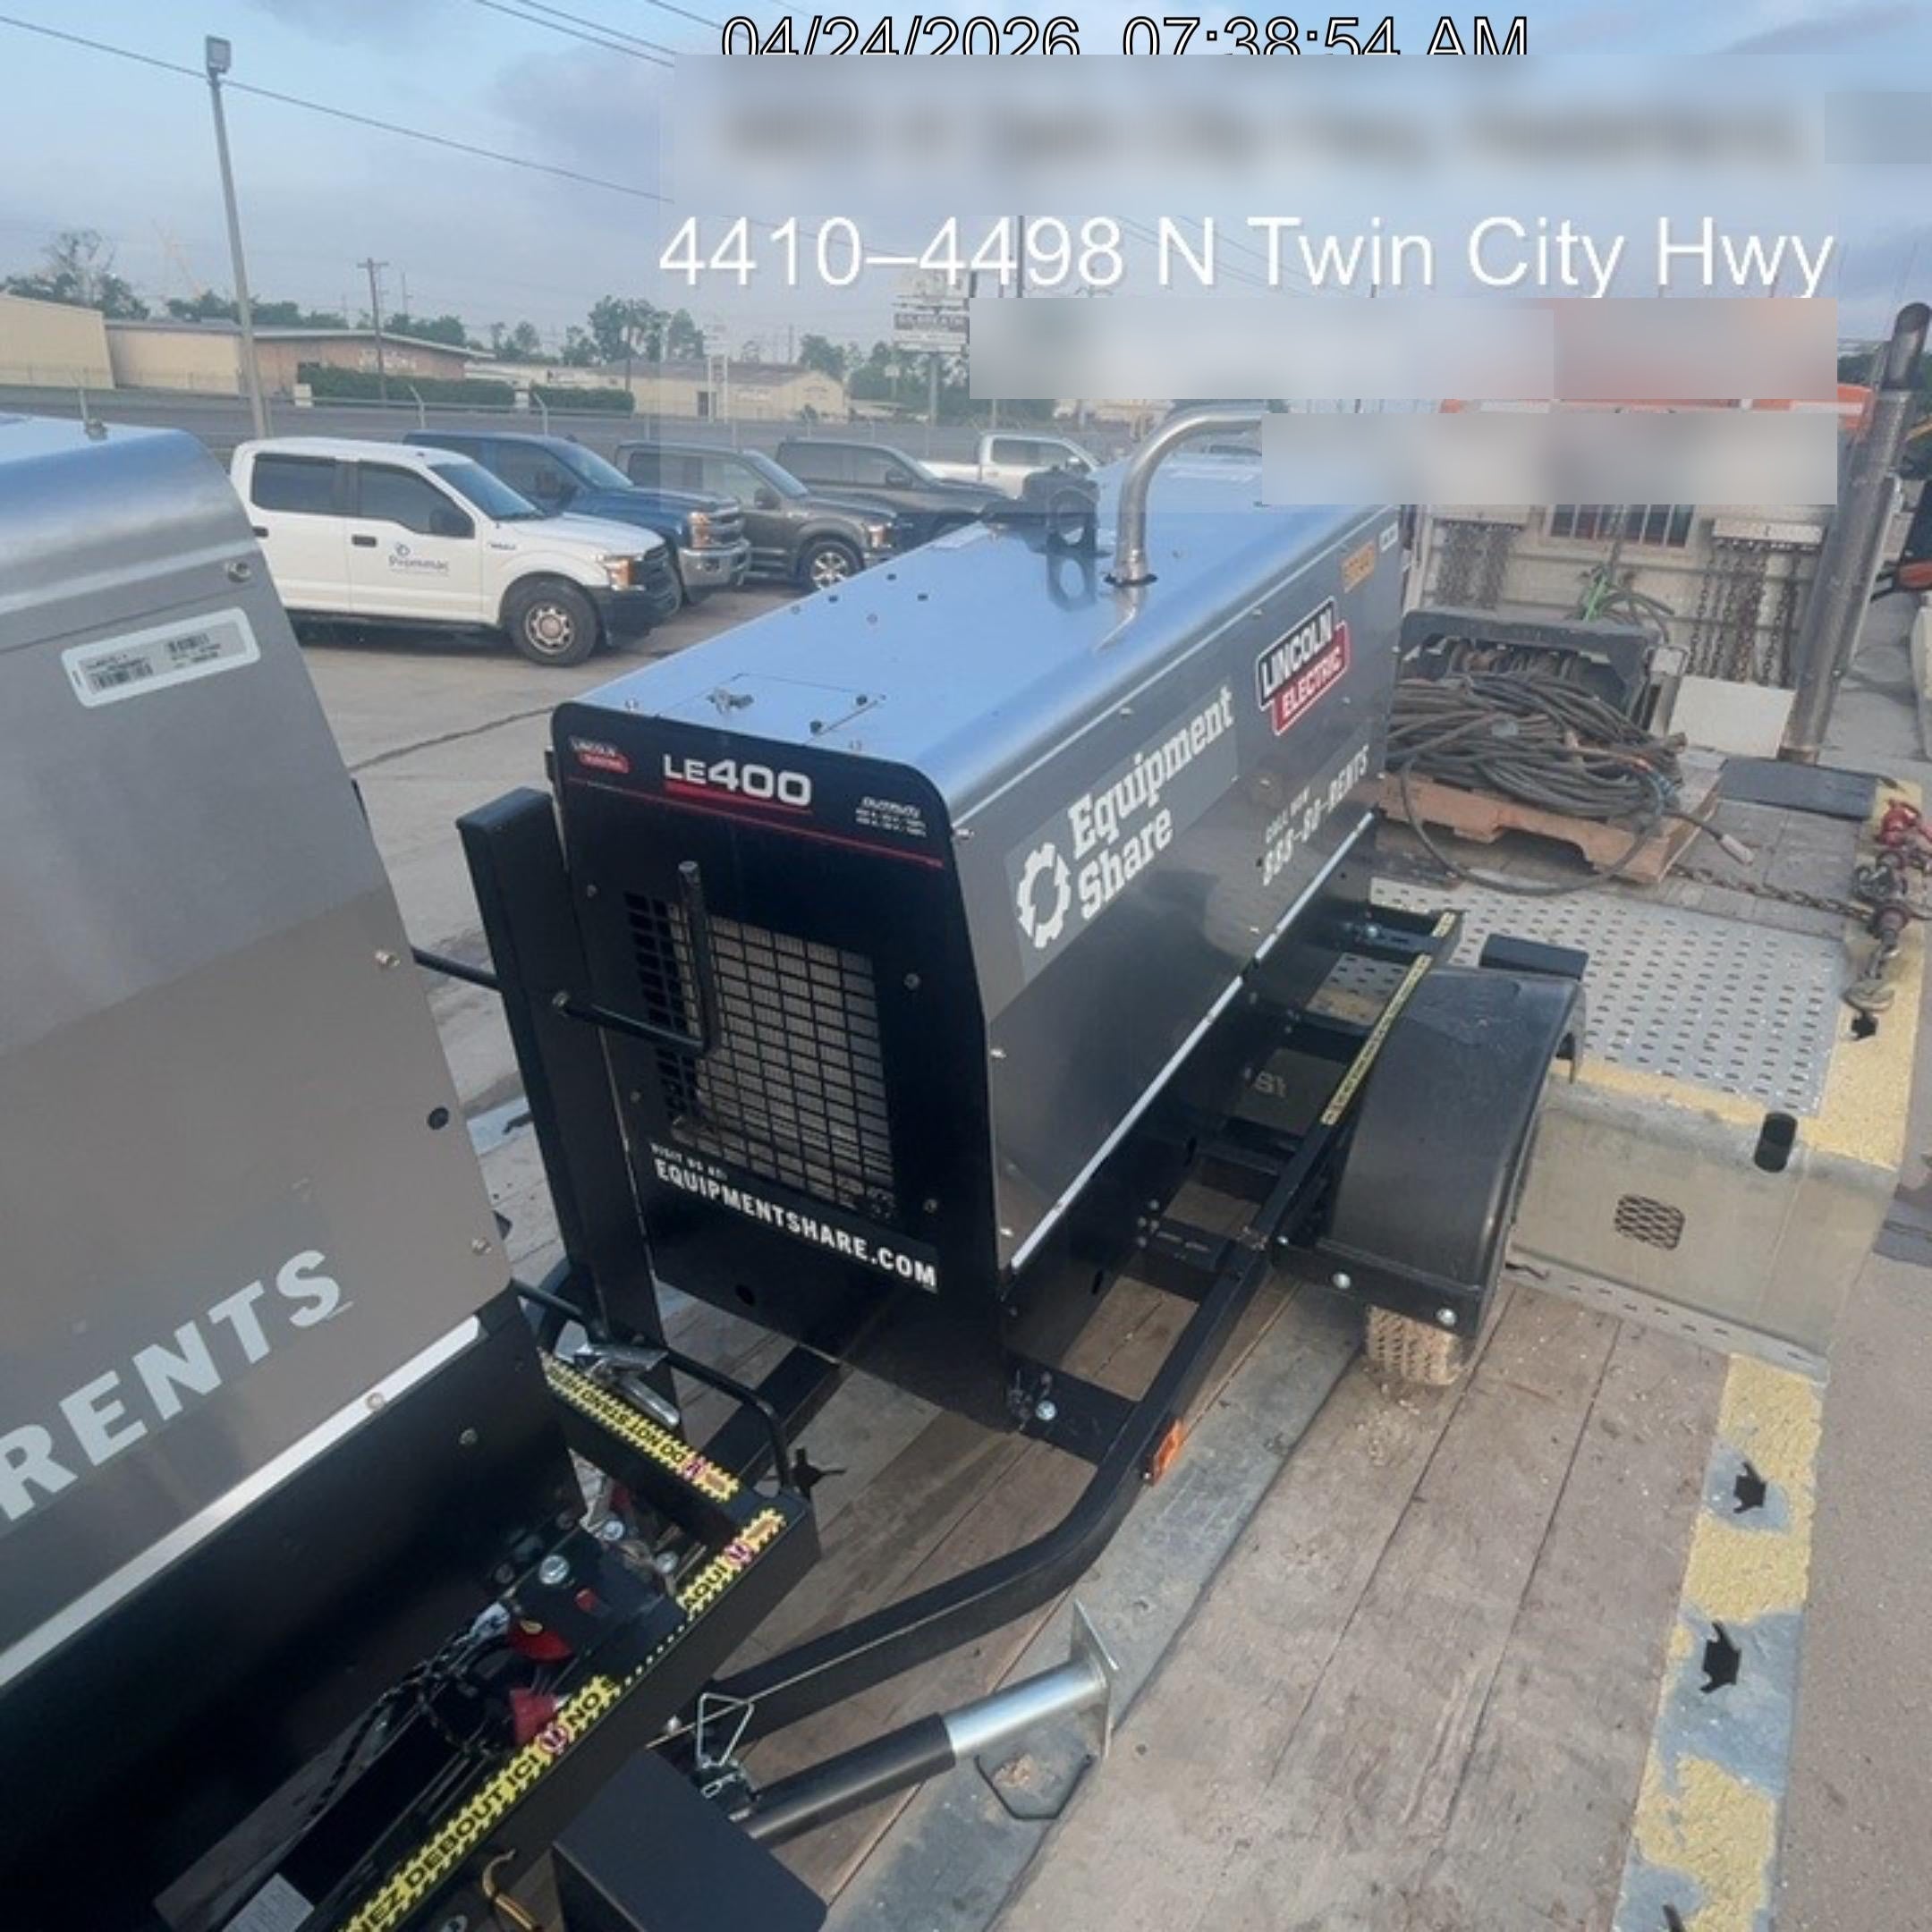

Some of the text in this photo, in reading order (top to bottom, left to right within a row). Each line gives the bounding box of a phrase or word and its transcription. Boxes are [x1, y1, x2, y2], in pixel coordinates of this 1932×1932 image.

[1260, 606, 1334, 699] LINCOLN
[1281, 644, 1343, 719] ELECTRIC
[662, 752, 812, 807] LE400
[1067, 684, 1235, 860] Equipment
[1078, 808, 1174, 920] Share
[653, 1157, 936, 1288] EQUIPMENTSHARE.COM
[0, 1249, 341, 1521] RENTS
[566, 1691, 601, 1728] NO
[403, 1787, 506, 1890] DEBOUT
